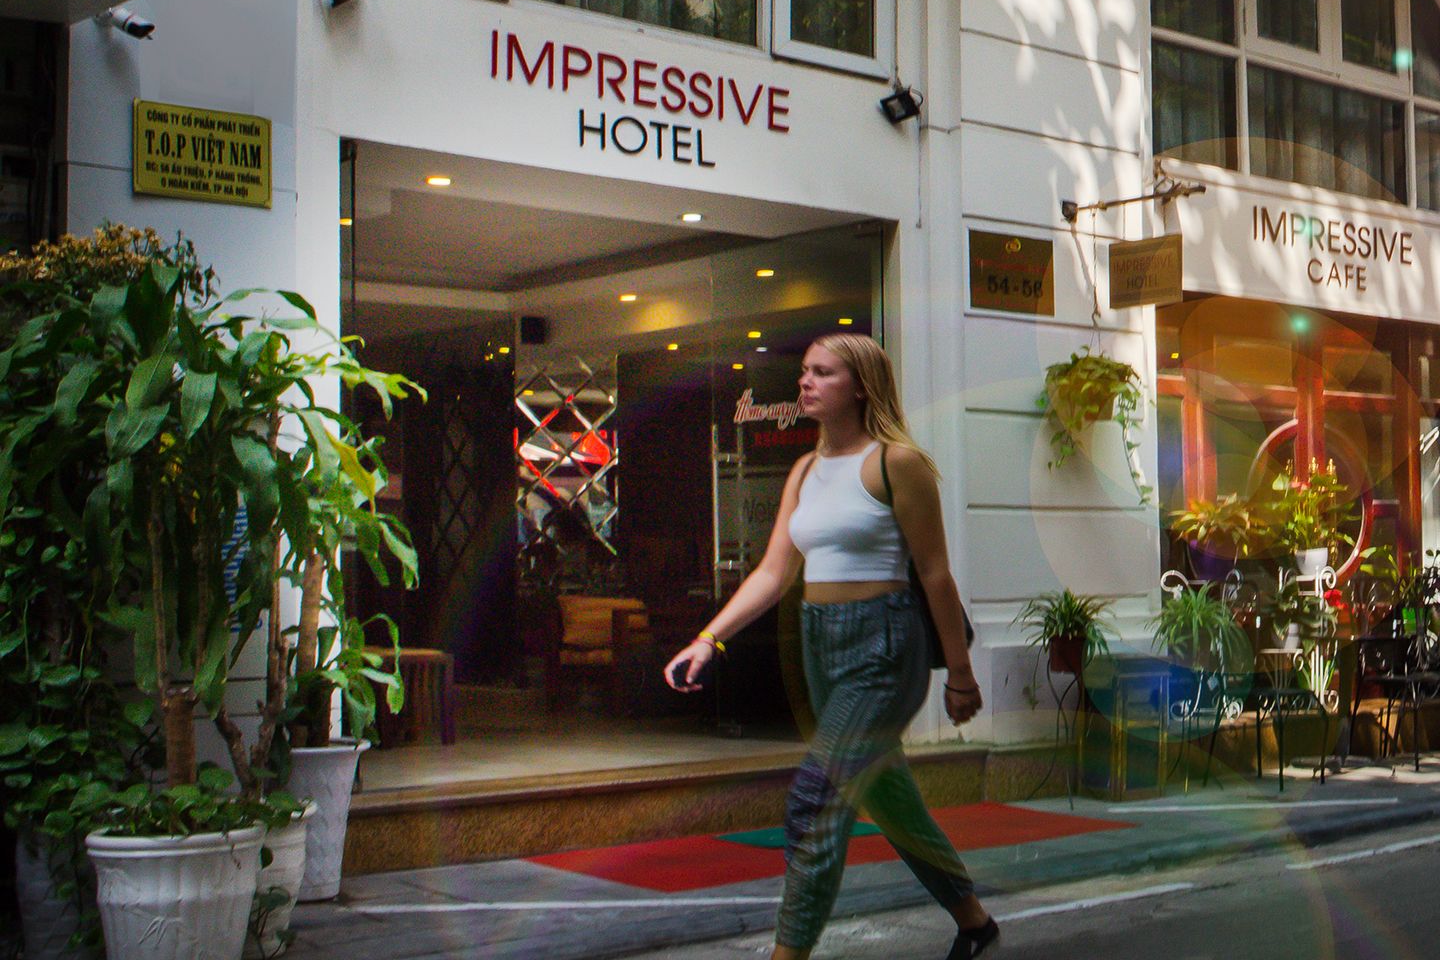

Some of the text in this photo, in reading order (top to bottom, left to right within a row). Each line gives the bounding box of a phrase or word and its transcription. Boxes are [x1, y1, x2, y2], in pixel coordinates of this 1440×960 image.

[490, 28, 790, 133] IMPRESSIVE
[170, 112, 180, 125] TY
[145, 129, 261, 170] T.O.P VIỆT NAM
[578, 108, 716, 168] HOTEL
[1252, 205, 1413, 265] IMPRESSIVE
[1113, 254, 1174, 275] IMPRESSIVE
[1126, 274, 1159, 290] HOTEL
[1307, 257, 1367, 291] CAFE
